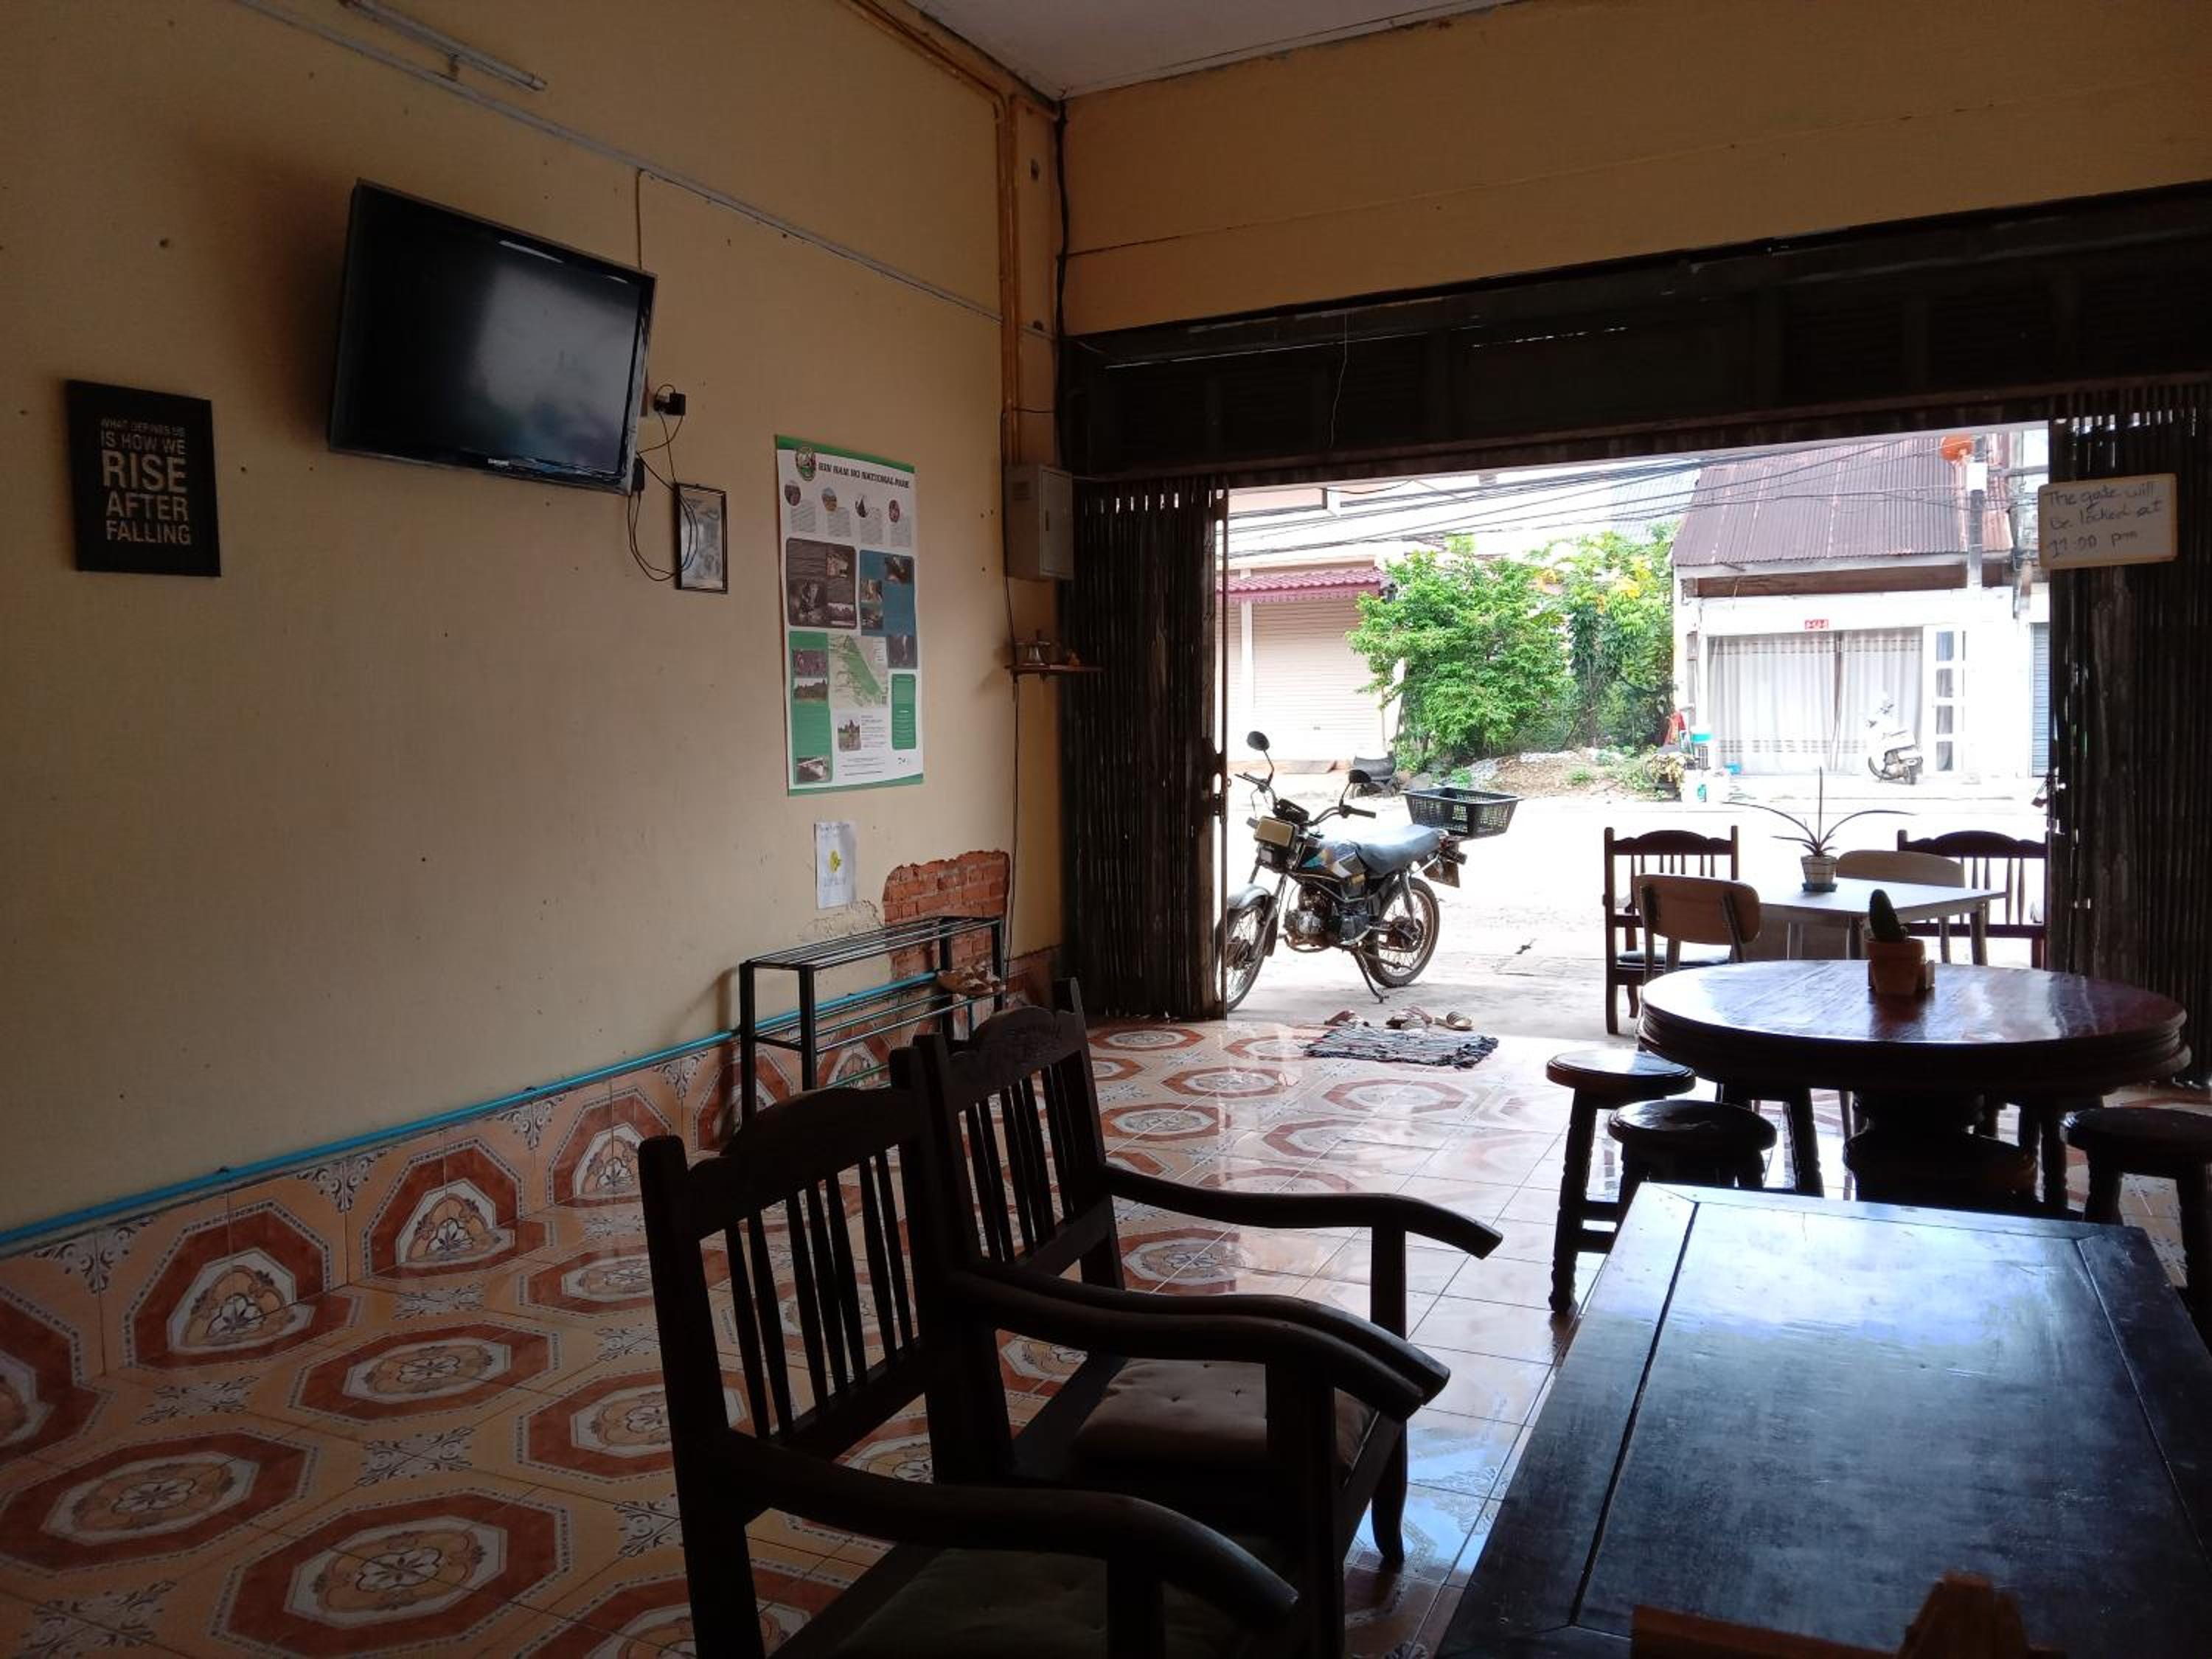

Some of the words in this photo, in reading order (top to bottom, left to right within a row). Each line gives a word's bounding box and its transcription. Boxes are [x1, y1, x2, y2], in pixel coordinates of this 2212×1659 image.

[100, 429, 116, 448] IS
[121, 433, 157, 451] HOW
[162, 437, 186, 456] WE
[101, 448, 188, 493] RISE
[106, 490, 189, 522] AFTER
[2042, 490, 2077, 507] The
[2080, 484, 2121, 514] gate
[2124, 482, 2154, 498] will
[2079, 502, 2130, 526] locked
[2136, 495, 2163, 518] at
[106, 520, 192, 546] FALLING
